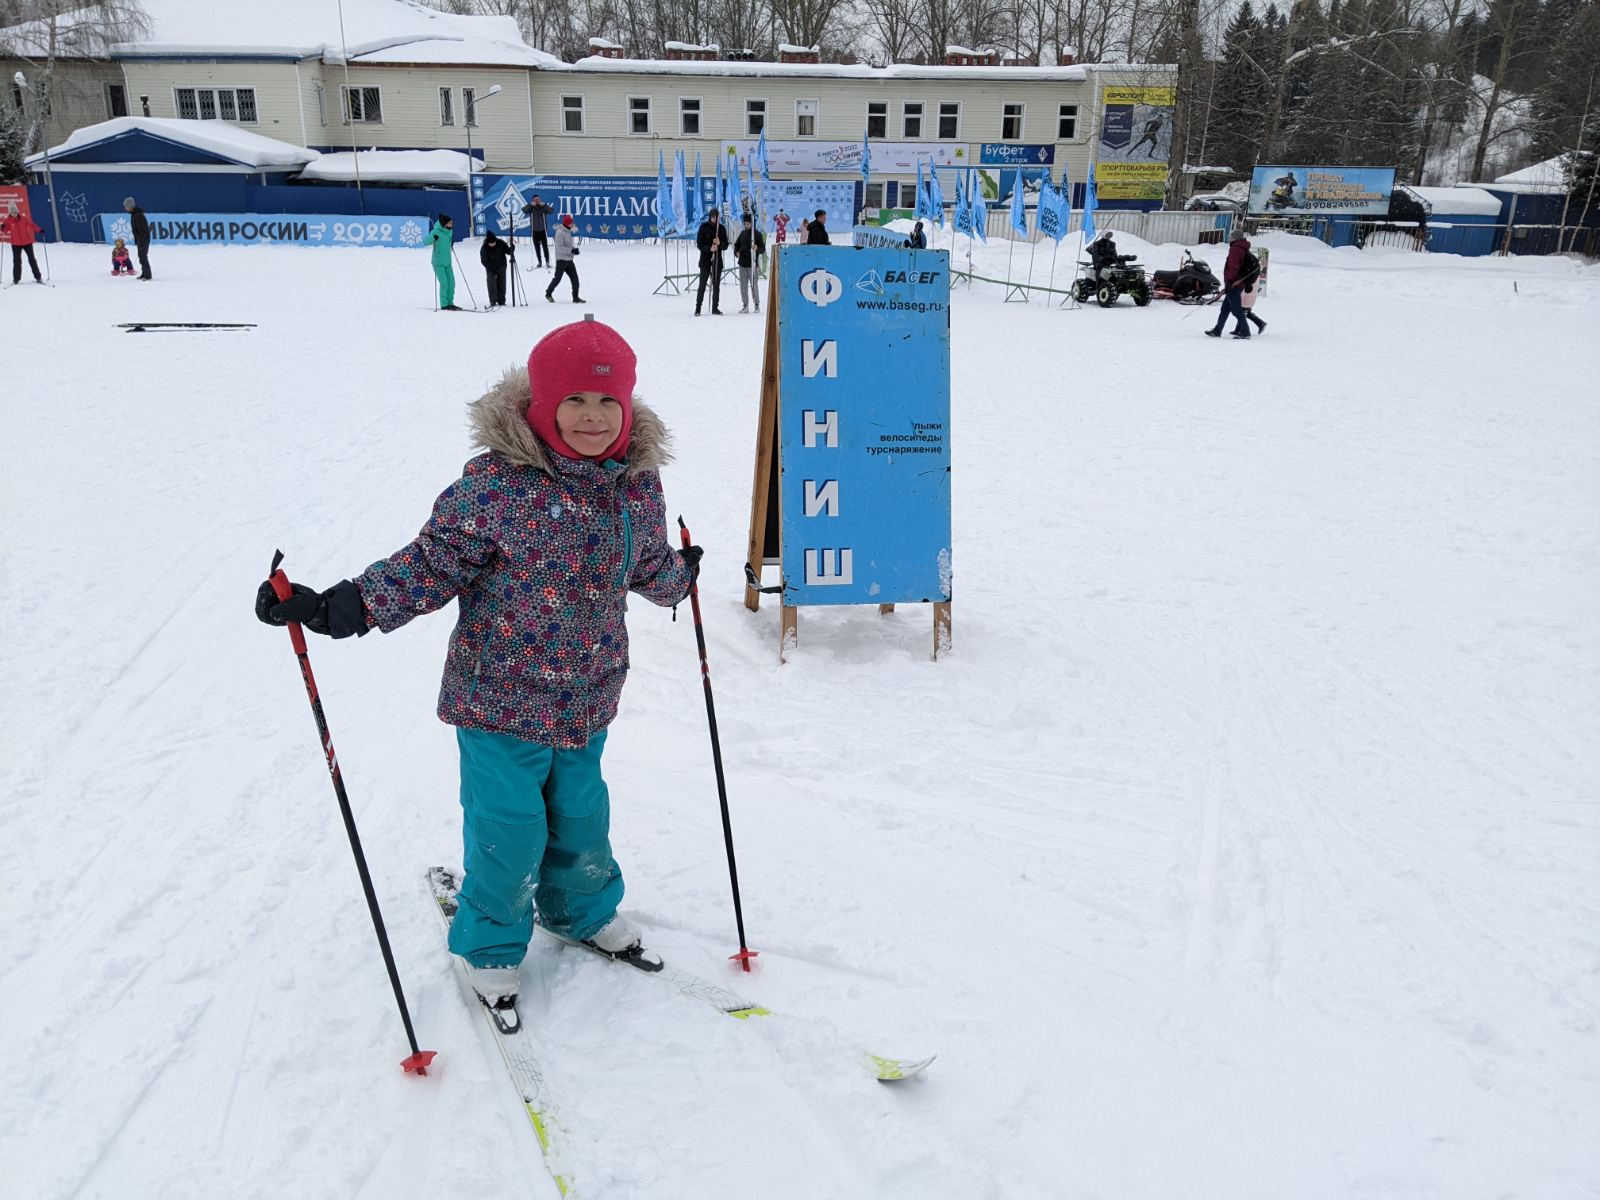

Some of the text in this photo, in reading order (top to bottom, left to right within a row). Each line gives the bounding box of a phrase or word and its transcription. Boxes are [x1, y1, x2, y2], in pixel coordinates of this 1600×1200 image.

[985, 144, 1025, 157] Буфет
[228, 221, 308, 241] РОССИИ
[332, 222, 393, 243] 2022
[884, 270, 940, 284] БАСЕГ
[856, 300, 942, 313] www.baseg.ru
[799, 267, 853, 586] ФИНИШ
[880, 434, 942, 443] велосипеды
[865, 446, 943, 455] турснаряжение
